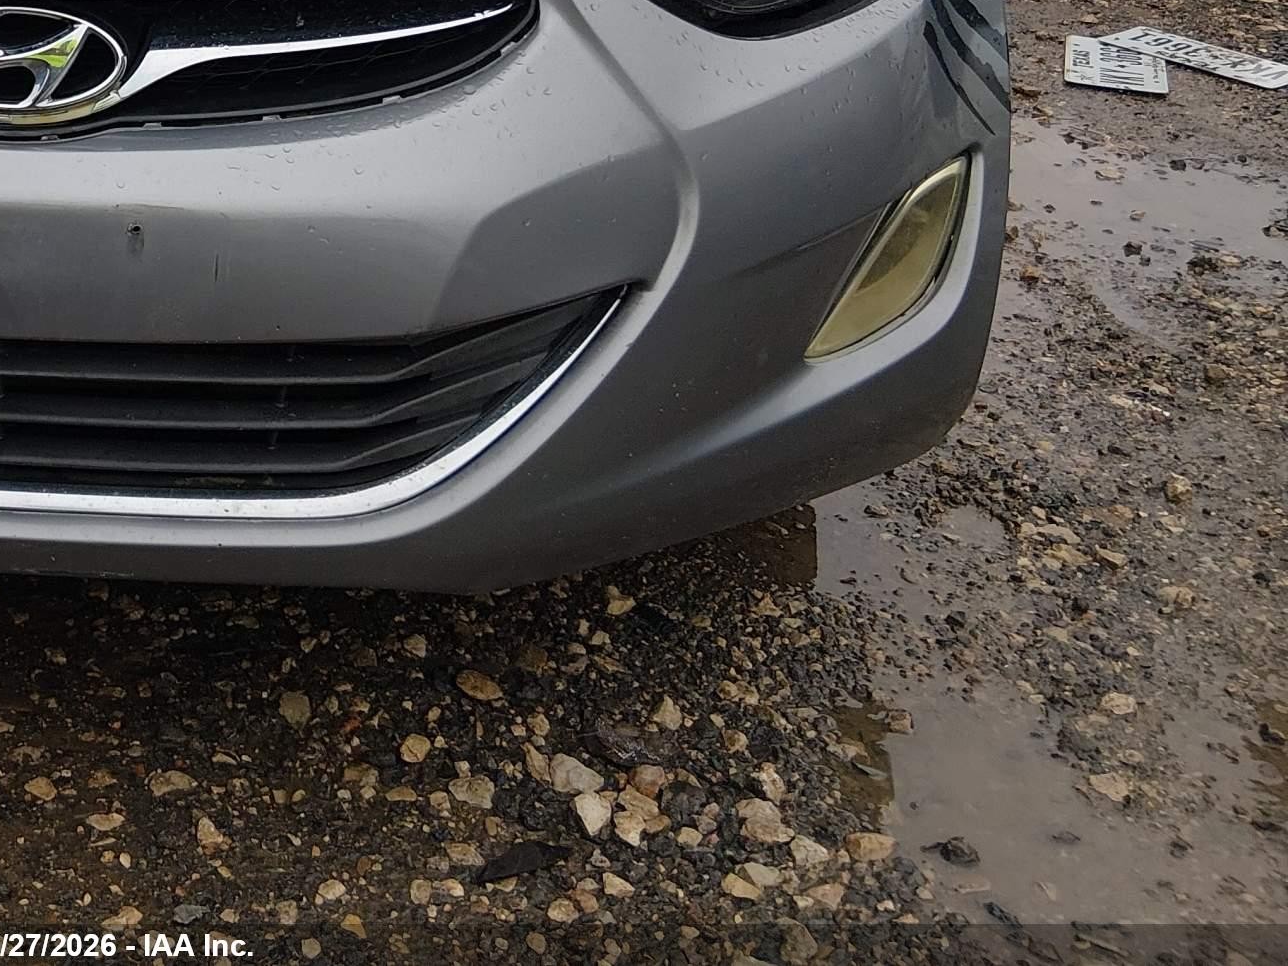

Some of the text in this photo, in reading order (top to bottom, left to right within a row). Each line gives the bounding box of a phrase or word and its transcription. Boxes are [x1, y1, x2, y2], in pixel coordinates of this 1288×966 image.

[1128, 32, 1207, 57] 3661
[1072, 49, 1094, 69] TEXAS
[1156, 50, 1219, 72] TEXAS
